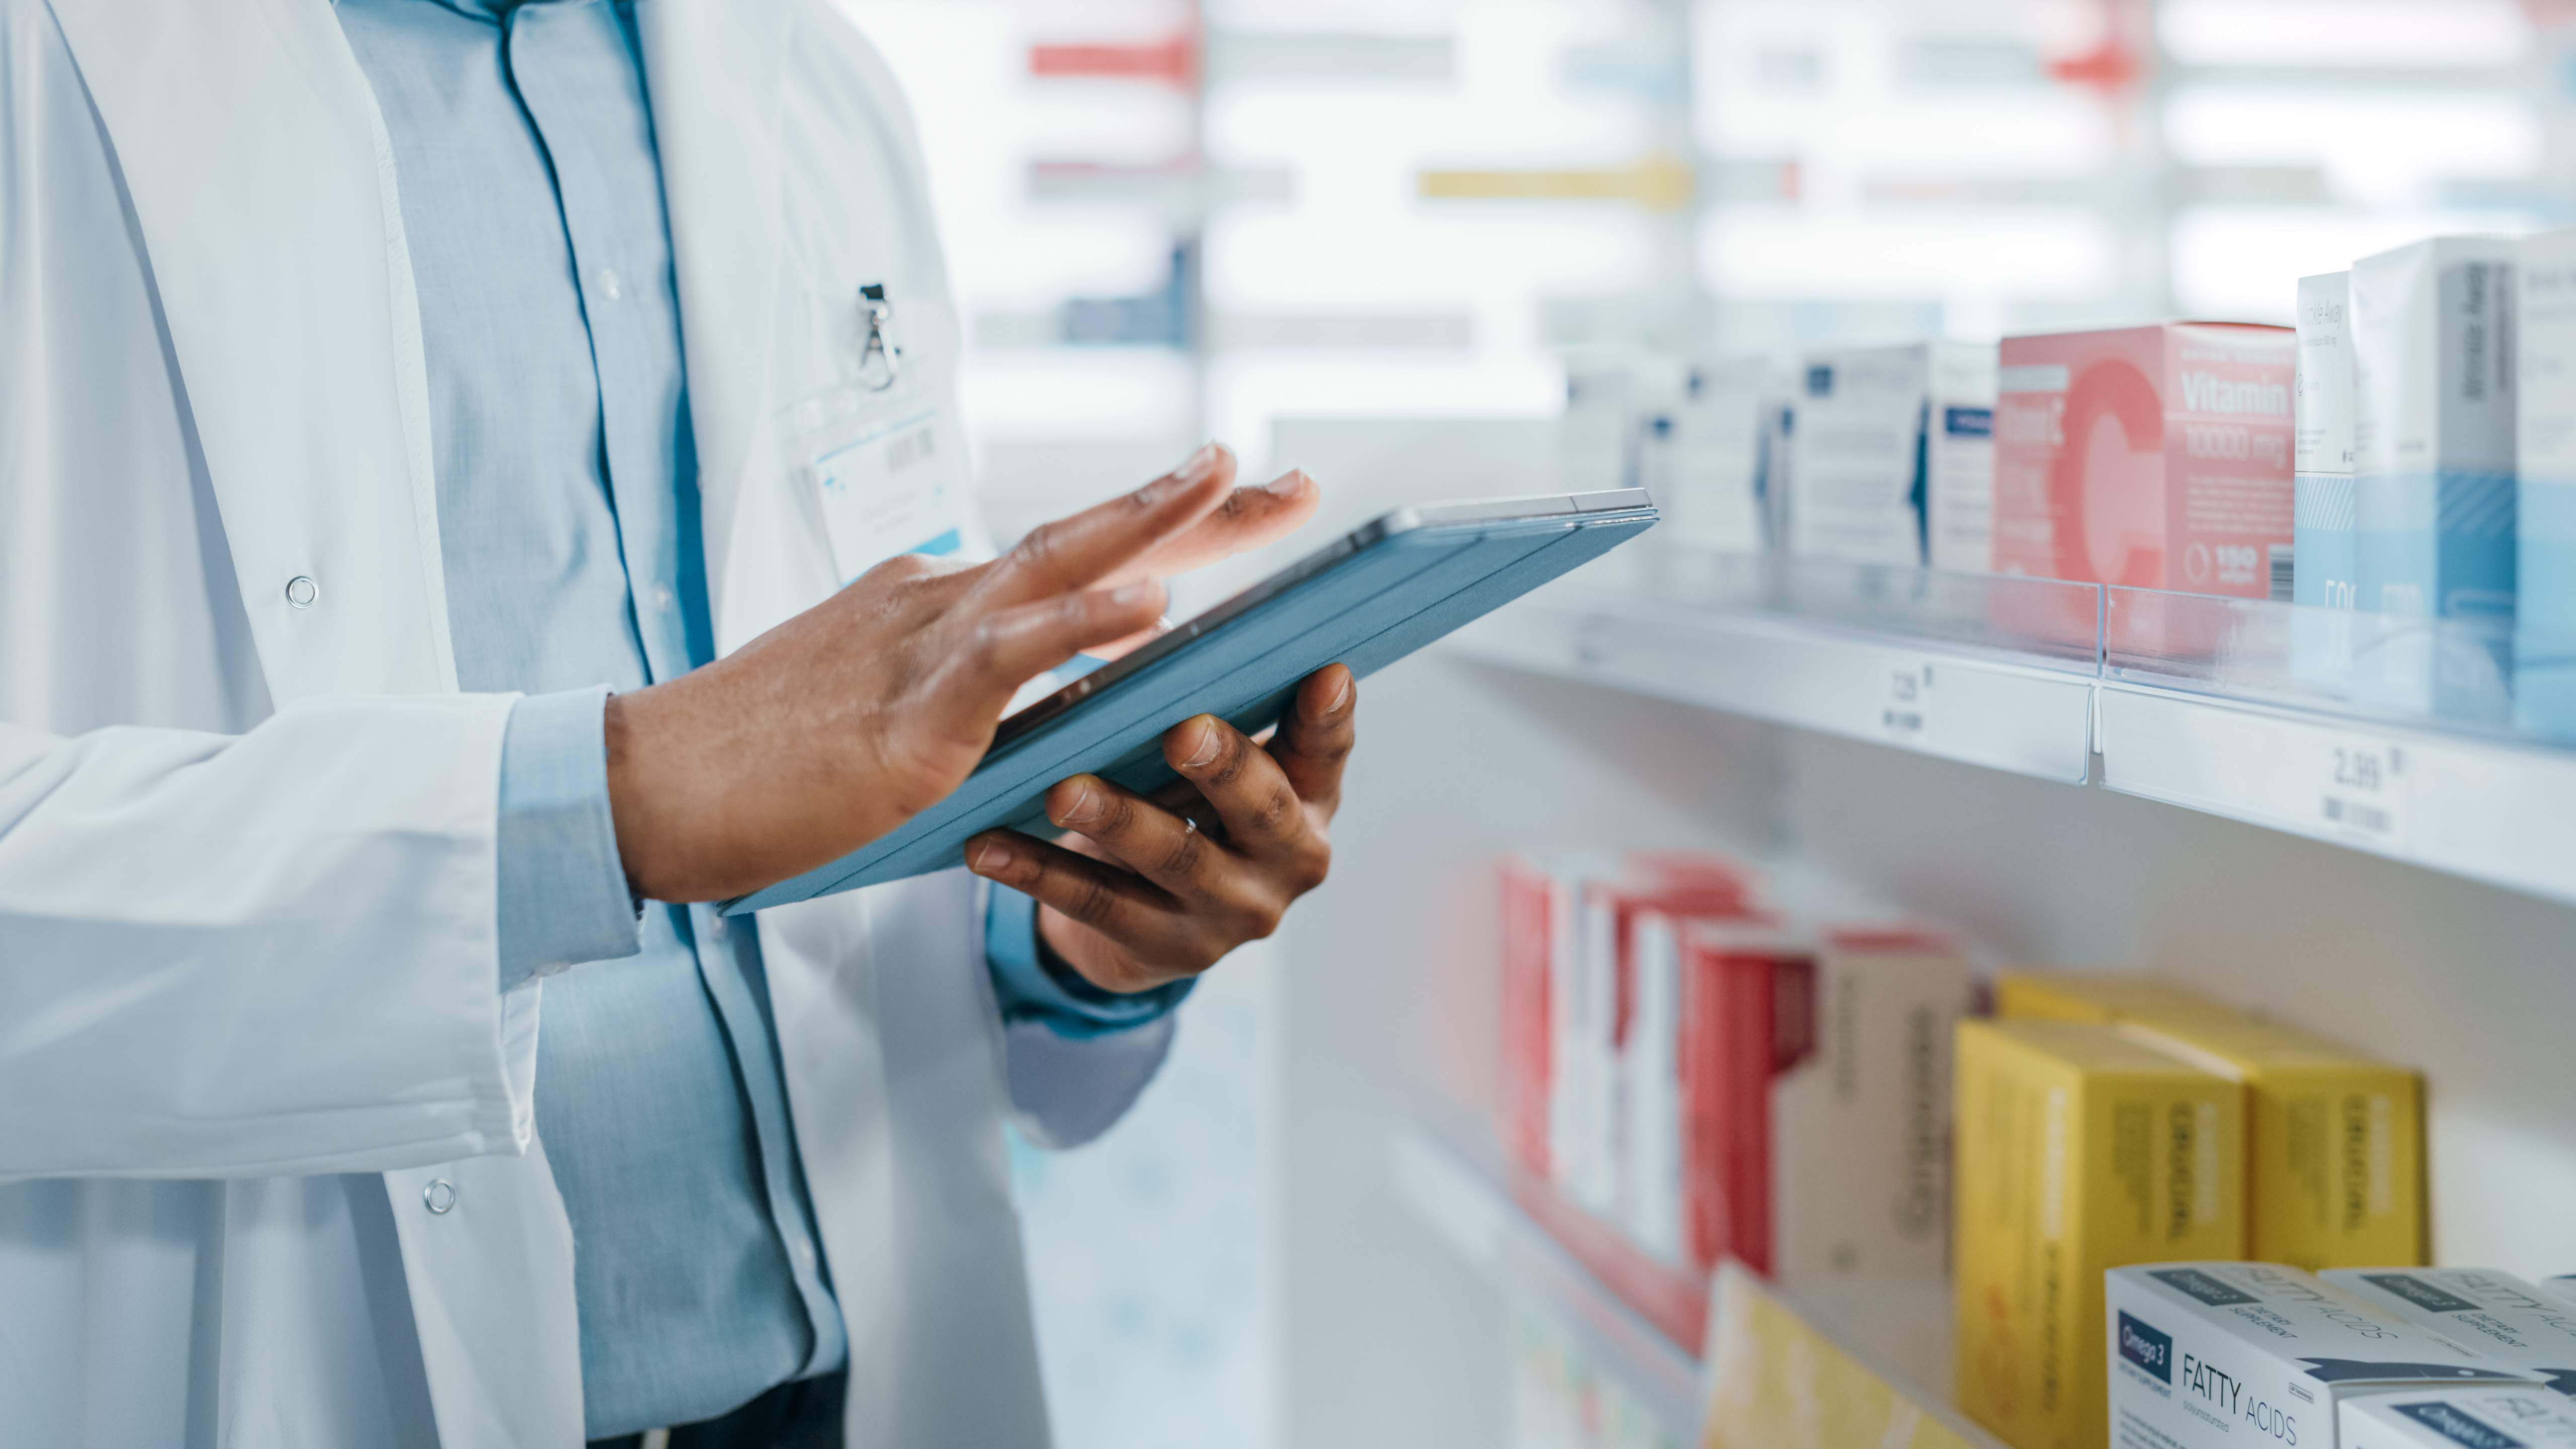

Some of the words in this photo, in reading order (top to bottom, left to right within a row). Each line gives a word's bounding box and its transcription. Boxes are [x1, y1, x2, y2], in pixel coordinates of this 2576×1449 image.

[2323, 300, 2343, 330] Away
[2181, 370, 2288, 416] Vitamin
[2185, 423, 2249, 461] 10000
[2332, 746, 2383, 792] 2.99
[2229, 1308, 2299, 1339] SUPPLEMENT
[2451, 1314, 2529, 1348] SUPPLEMENT
[2122, 1324, 2156, 1363] Omega
[2157, 1344, 2165, 1365] 3
[2183, 1353, 2241, 1414] FATTY
[2245, 1396, 2297, 1446] ACIDS
[2183, 1400, 2229, 1433] polyunsaturated
